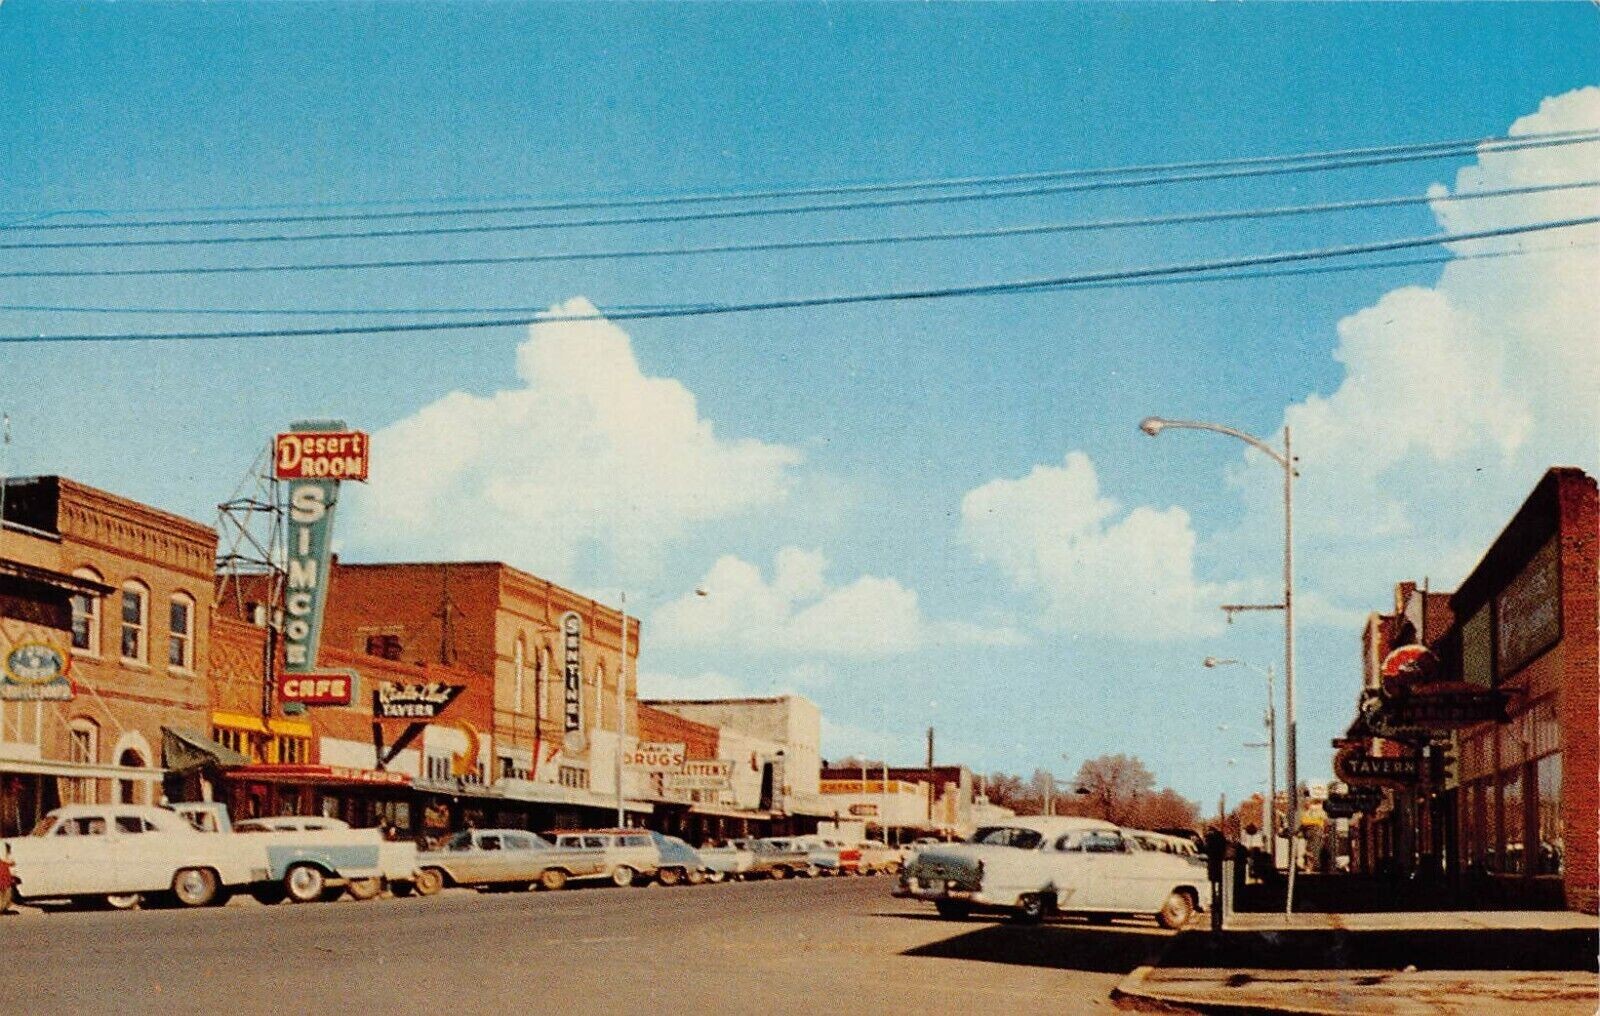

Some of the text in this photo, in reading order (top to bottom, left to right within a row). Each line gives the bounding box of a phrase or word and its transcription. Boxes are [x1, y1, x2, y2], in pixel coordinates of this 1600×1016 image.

[279, 434, 361, 470] Desert
[301, 456, 362, 477] ROOM
[286, 485, 326, 664] SIMCOE
[283, 679, 346, 698] CAFE
[383, 703, 434, 717] TAVERN
[623, 753, 683, 766] DRUGS
[1350, 760, 1415, 772] TAVERN
